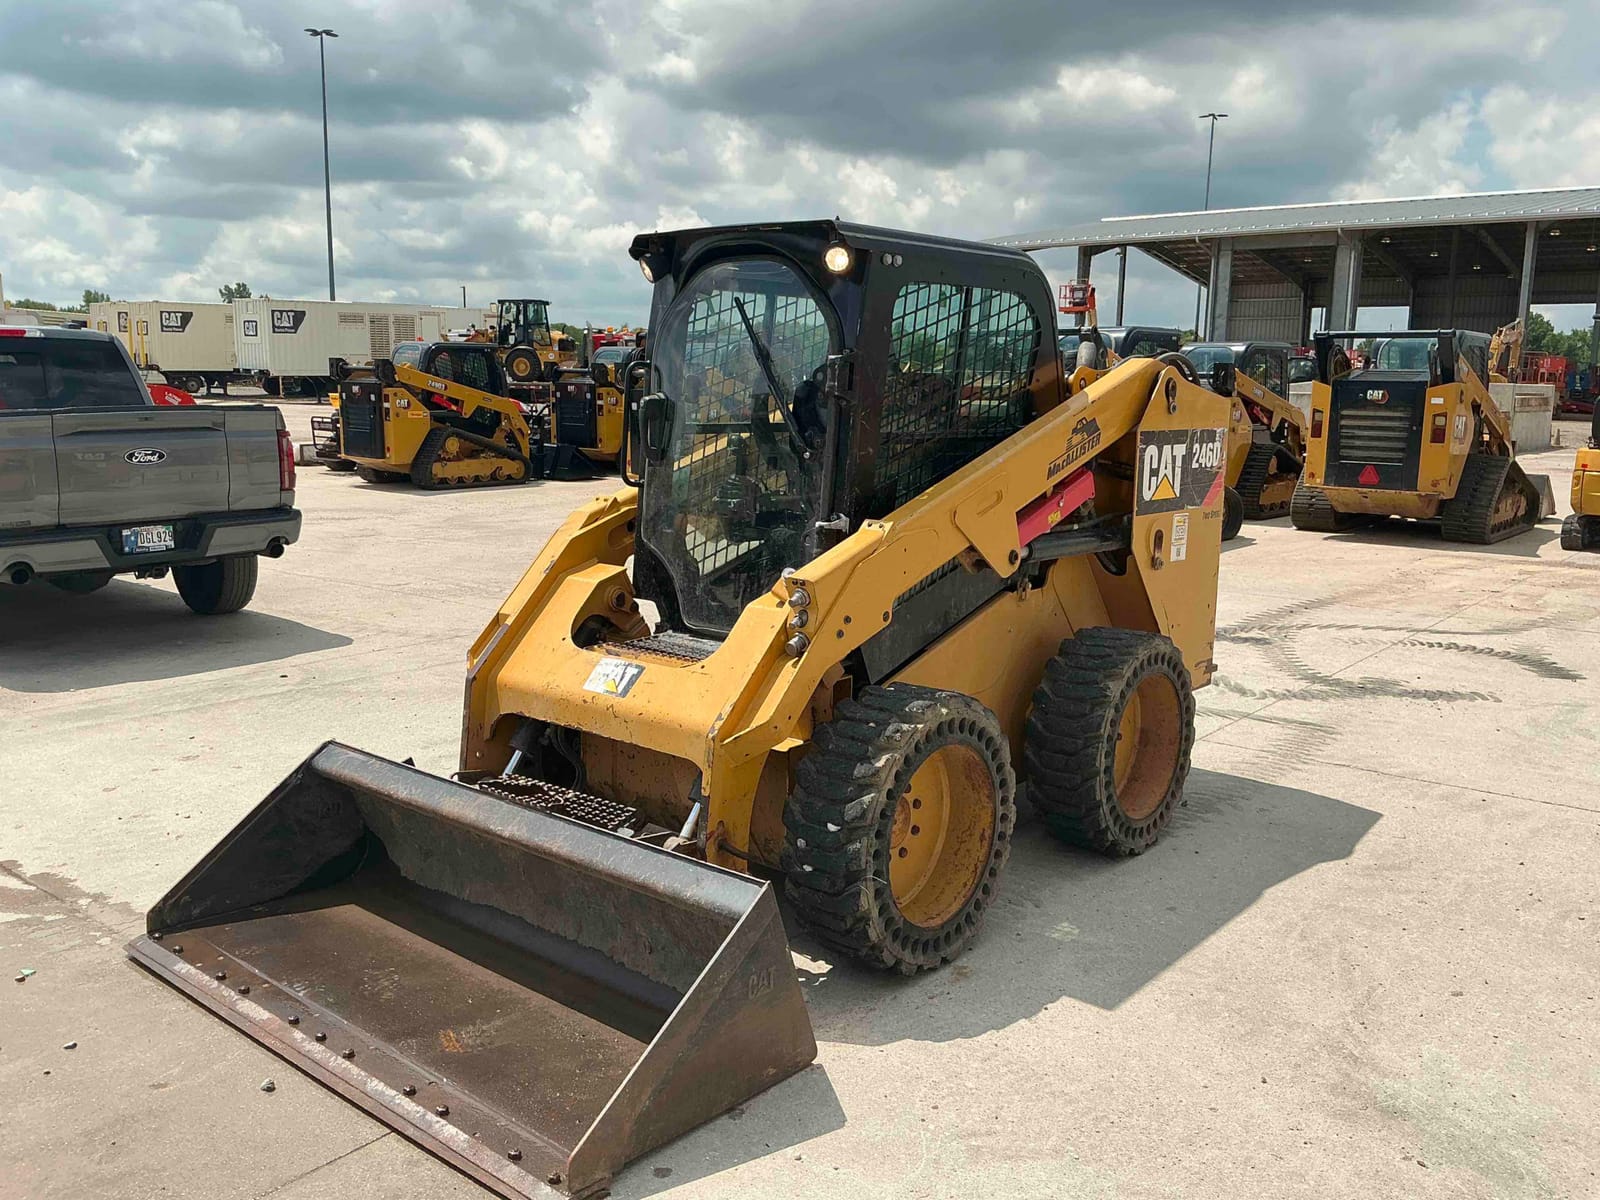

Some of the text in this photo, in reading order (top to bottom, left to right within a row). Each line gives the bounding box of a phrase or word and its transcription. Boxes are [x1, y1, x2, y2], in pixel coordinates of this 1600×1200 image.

[162, 312, 182, 326] CAT
[274, 311, 295, 327] CAT
[1367, 390, 1384, 400] CAT
[396, 399, 409, 408] CAT
[1454, 415, 1467, 438] CAT
[132, 450, 160, 462] Ford
[1191, 441, 1221, 469] 246D
[1142, 444, 1187, 501] CAT
[139, 531, 173, 544] DGL929
[749, 967, 776, 1000] CAT
